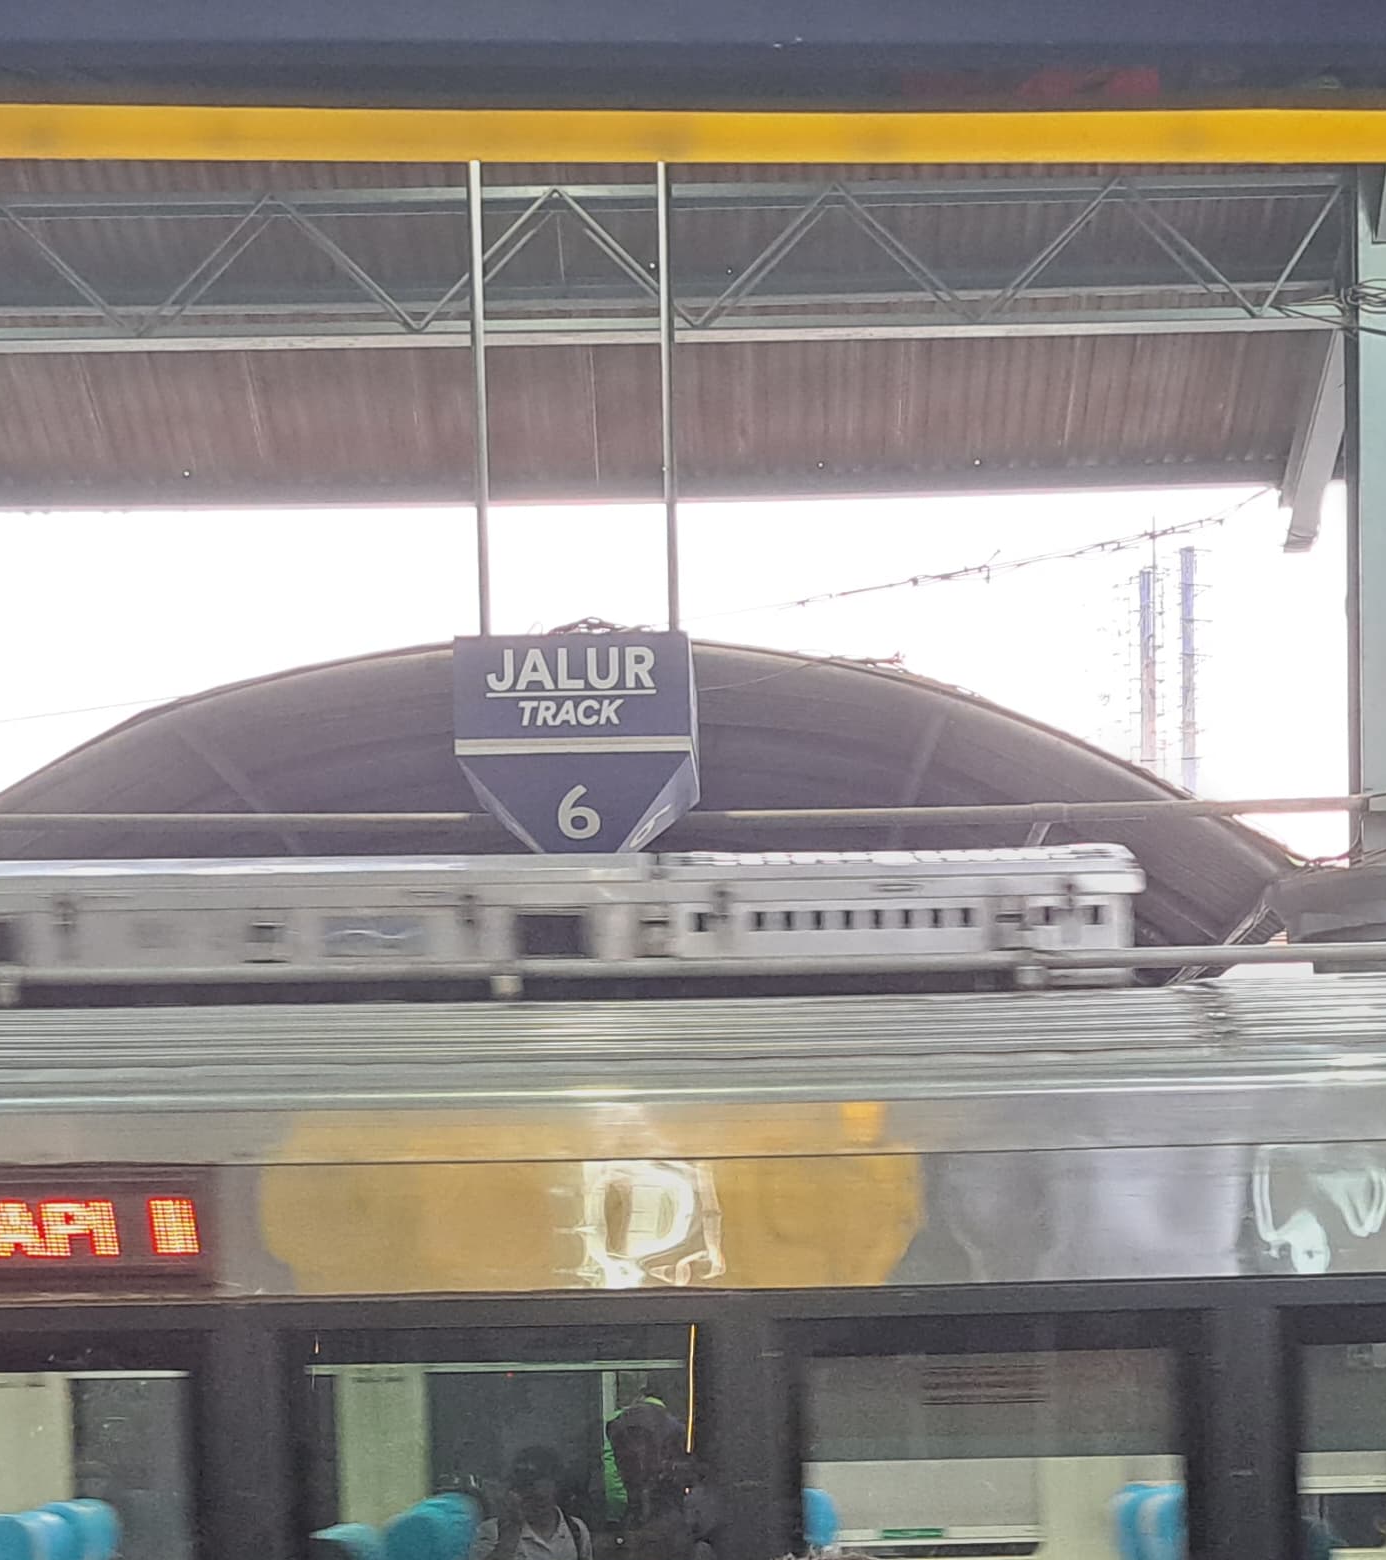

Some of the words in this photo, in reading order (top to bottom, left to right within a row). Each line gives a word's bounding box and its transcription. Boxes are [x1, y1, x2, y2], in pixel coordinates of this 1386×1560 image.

[486, 646, 655, 691] JALUR
[518, 699, 624, 726] TRACK
[558, 784, 601, 839] 6
